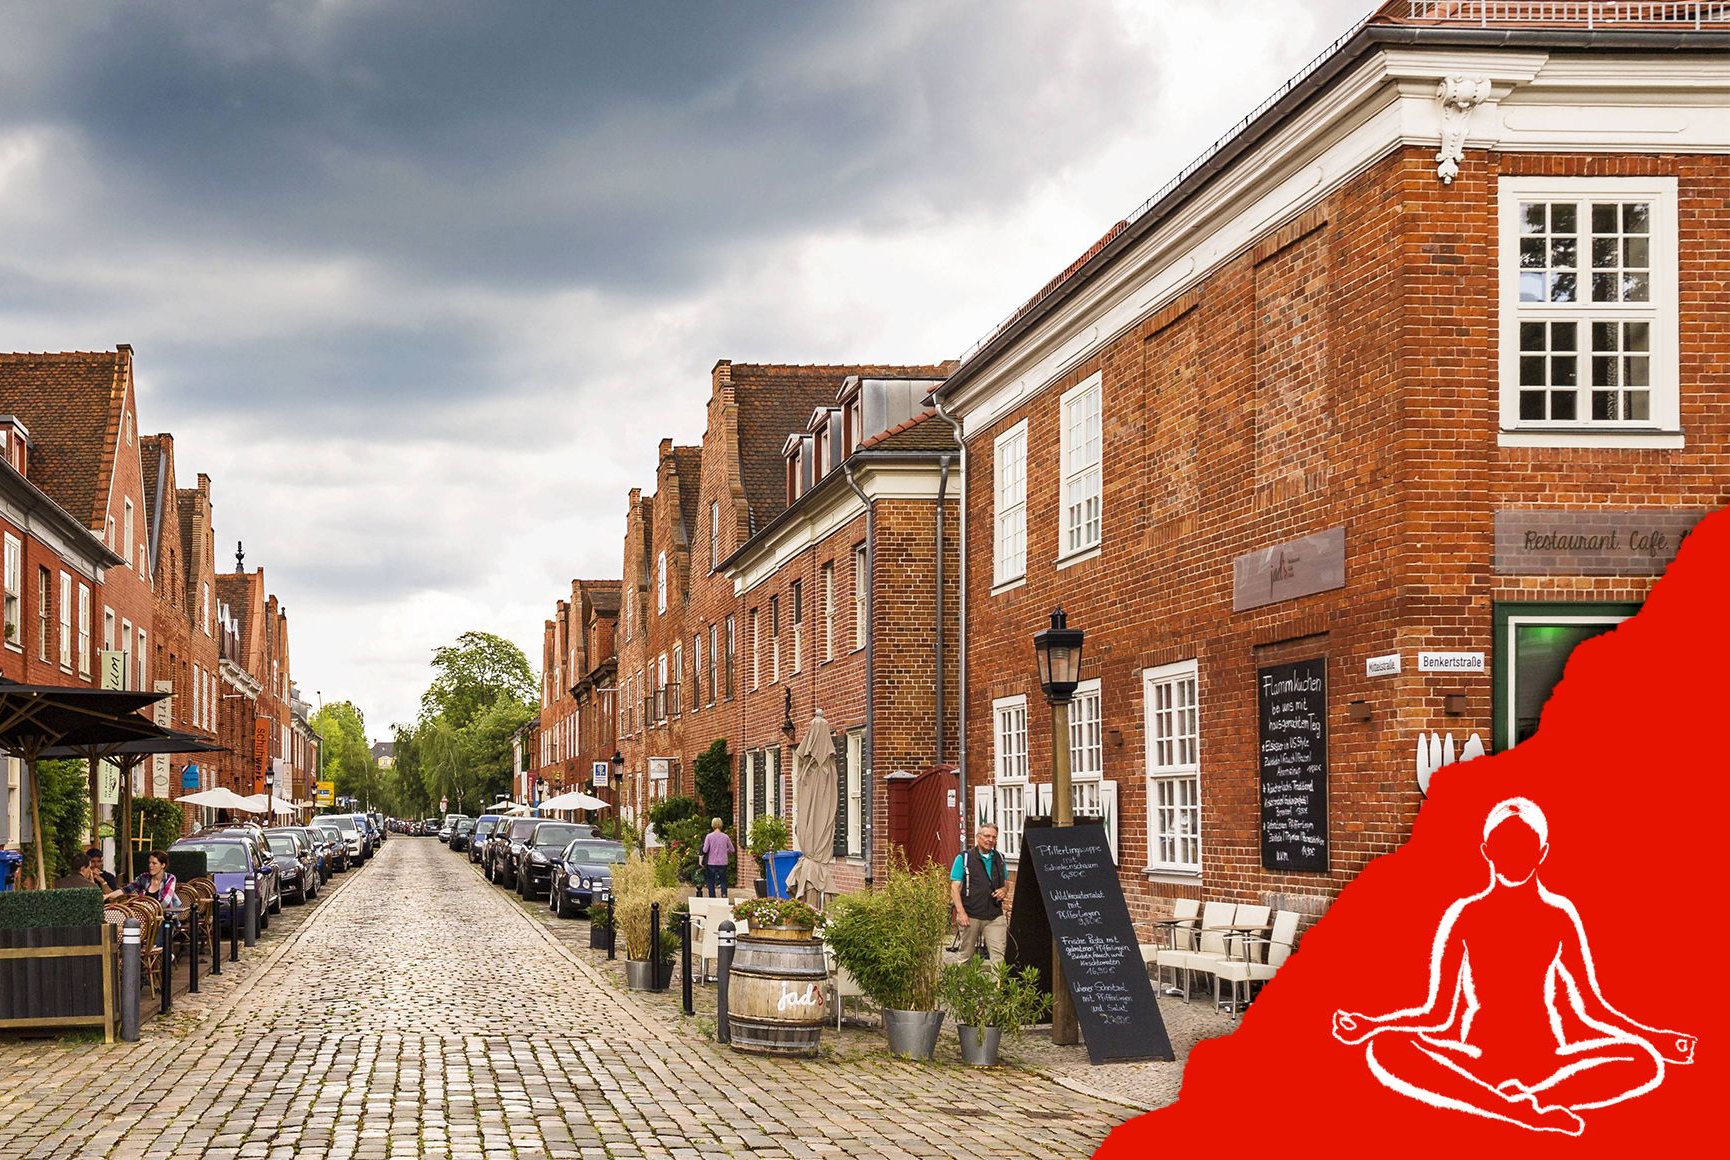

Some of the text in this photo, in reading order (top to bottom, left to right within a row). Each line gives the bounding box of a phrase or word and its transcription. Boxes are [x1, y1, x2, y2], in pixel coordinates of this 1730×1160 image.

[1368, 659, 1396, 673] Mittelstraße
[1423, 656, 1482, 668] Benkertstraße
[1263, 668, 1321, 697] Flammkuchen
[1282, 701, 1294, 713] uns
[1295, 697, 1308, 711] mit
[256, 727, 266, 782] schuhwerk
[1086, 933, 1105, 944] Pasta
[1106, 936, 1120, 944] mit
